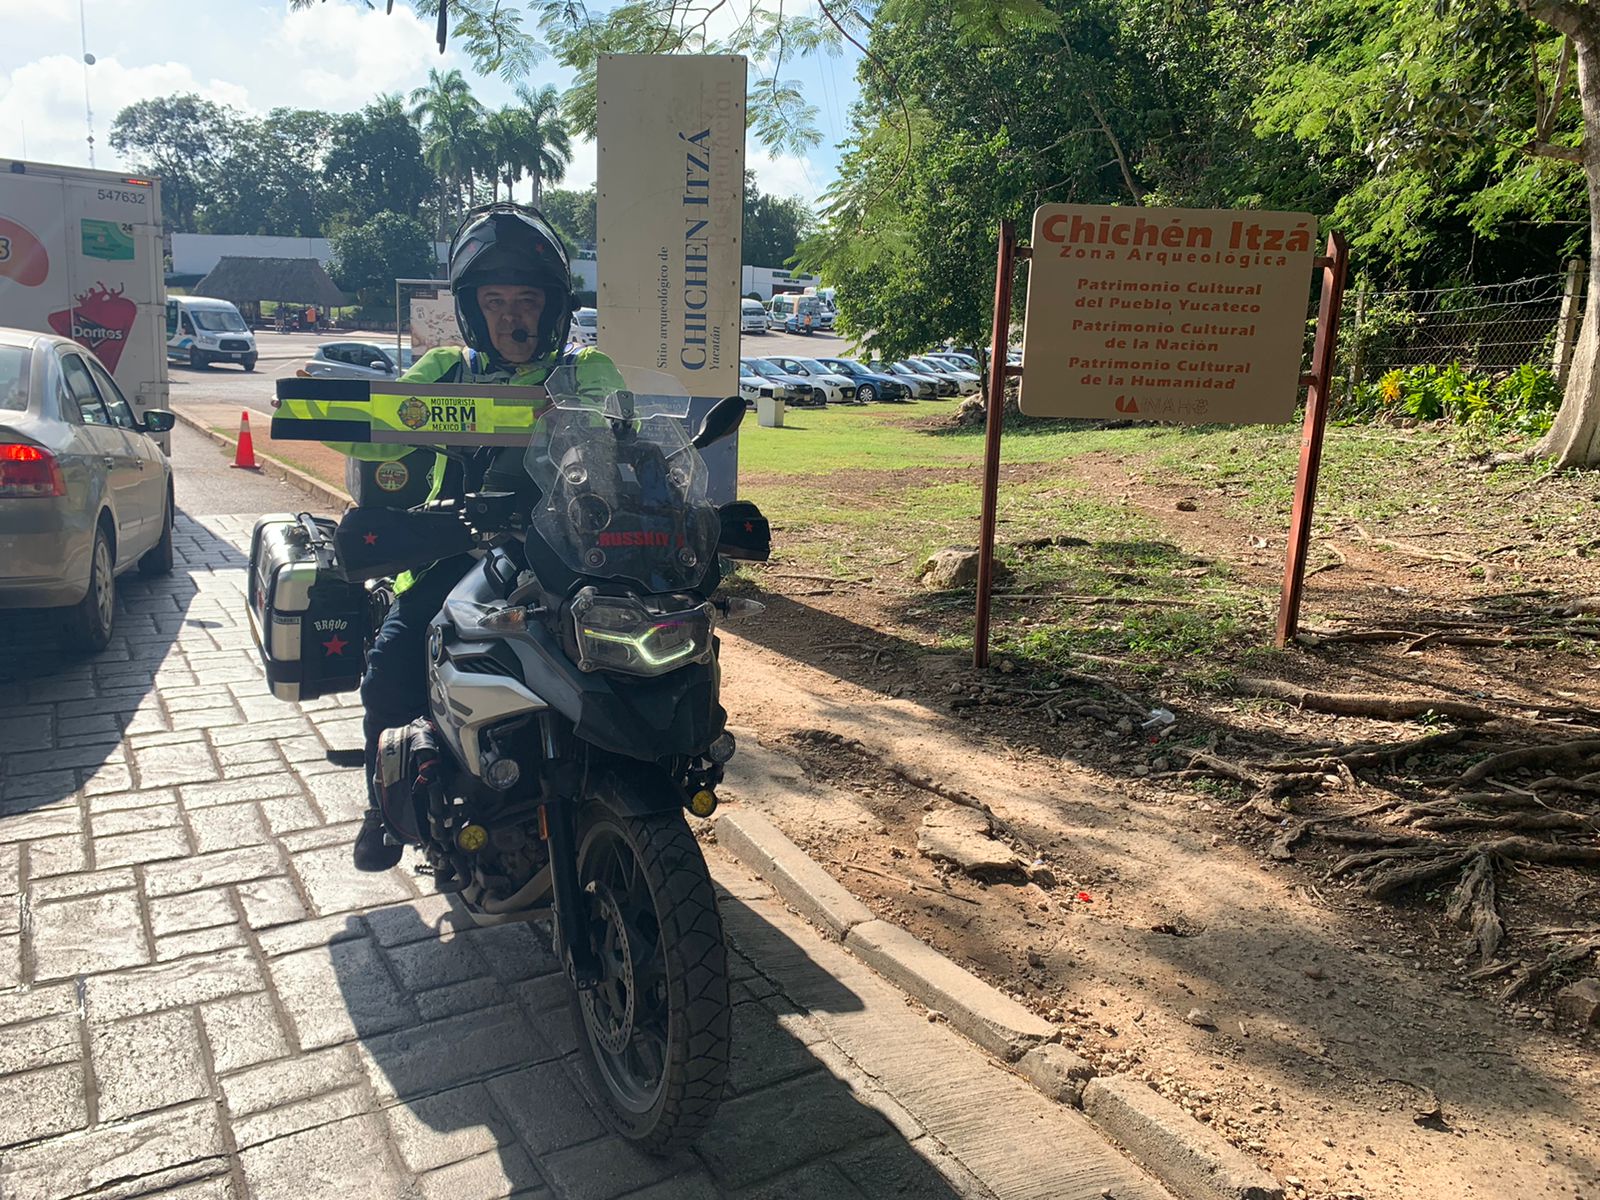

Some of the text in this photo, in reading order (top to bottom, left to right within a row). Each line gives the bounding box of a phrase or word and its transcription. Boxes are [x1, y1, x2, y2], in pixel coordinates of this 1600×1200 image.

[97, 189, 145, 205] 547632
[1042, 214, 1310, 252] Chichén Itzá
[678, 128, 710, 371] CHICHEN ITZÁ
[1059, 245, 1287, 269] Zona Arqueológica
[1077, 278, 1262, 296] Patrimonio Cultural
[656, 246, 671, 369] Sitio arqueológico de
[1074, 296, 1262, 314] del Pueblo Yucateco
[73, 324, 123, 340] Doritos
[1071, 319, 1256, 337] Patrimonio Cultural
[709, 325, 721, 371] Yucatán
[1104, 337, 1219, 353] de la Nación
[1067, 356, 1252, 375] Patrimonio Cultural
[1080, 374, 1237, 390] de la Humanidad
[430, 398, 476, 407] MOTOTURISTA
[431, 406, 476, 423] RRM
[313, 618, 349, 632] BRAVO
